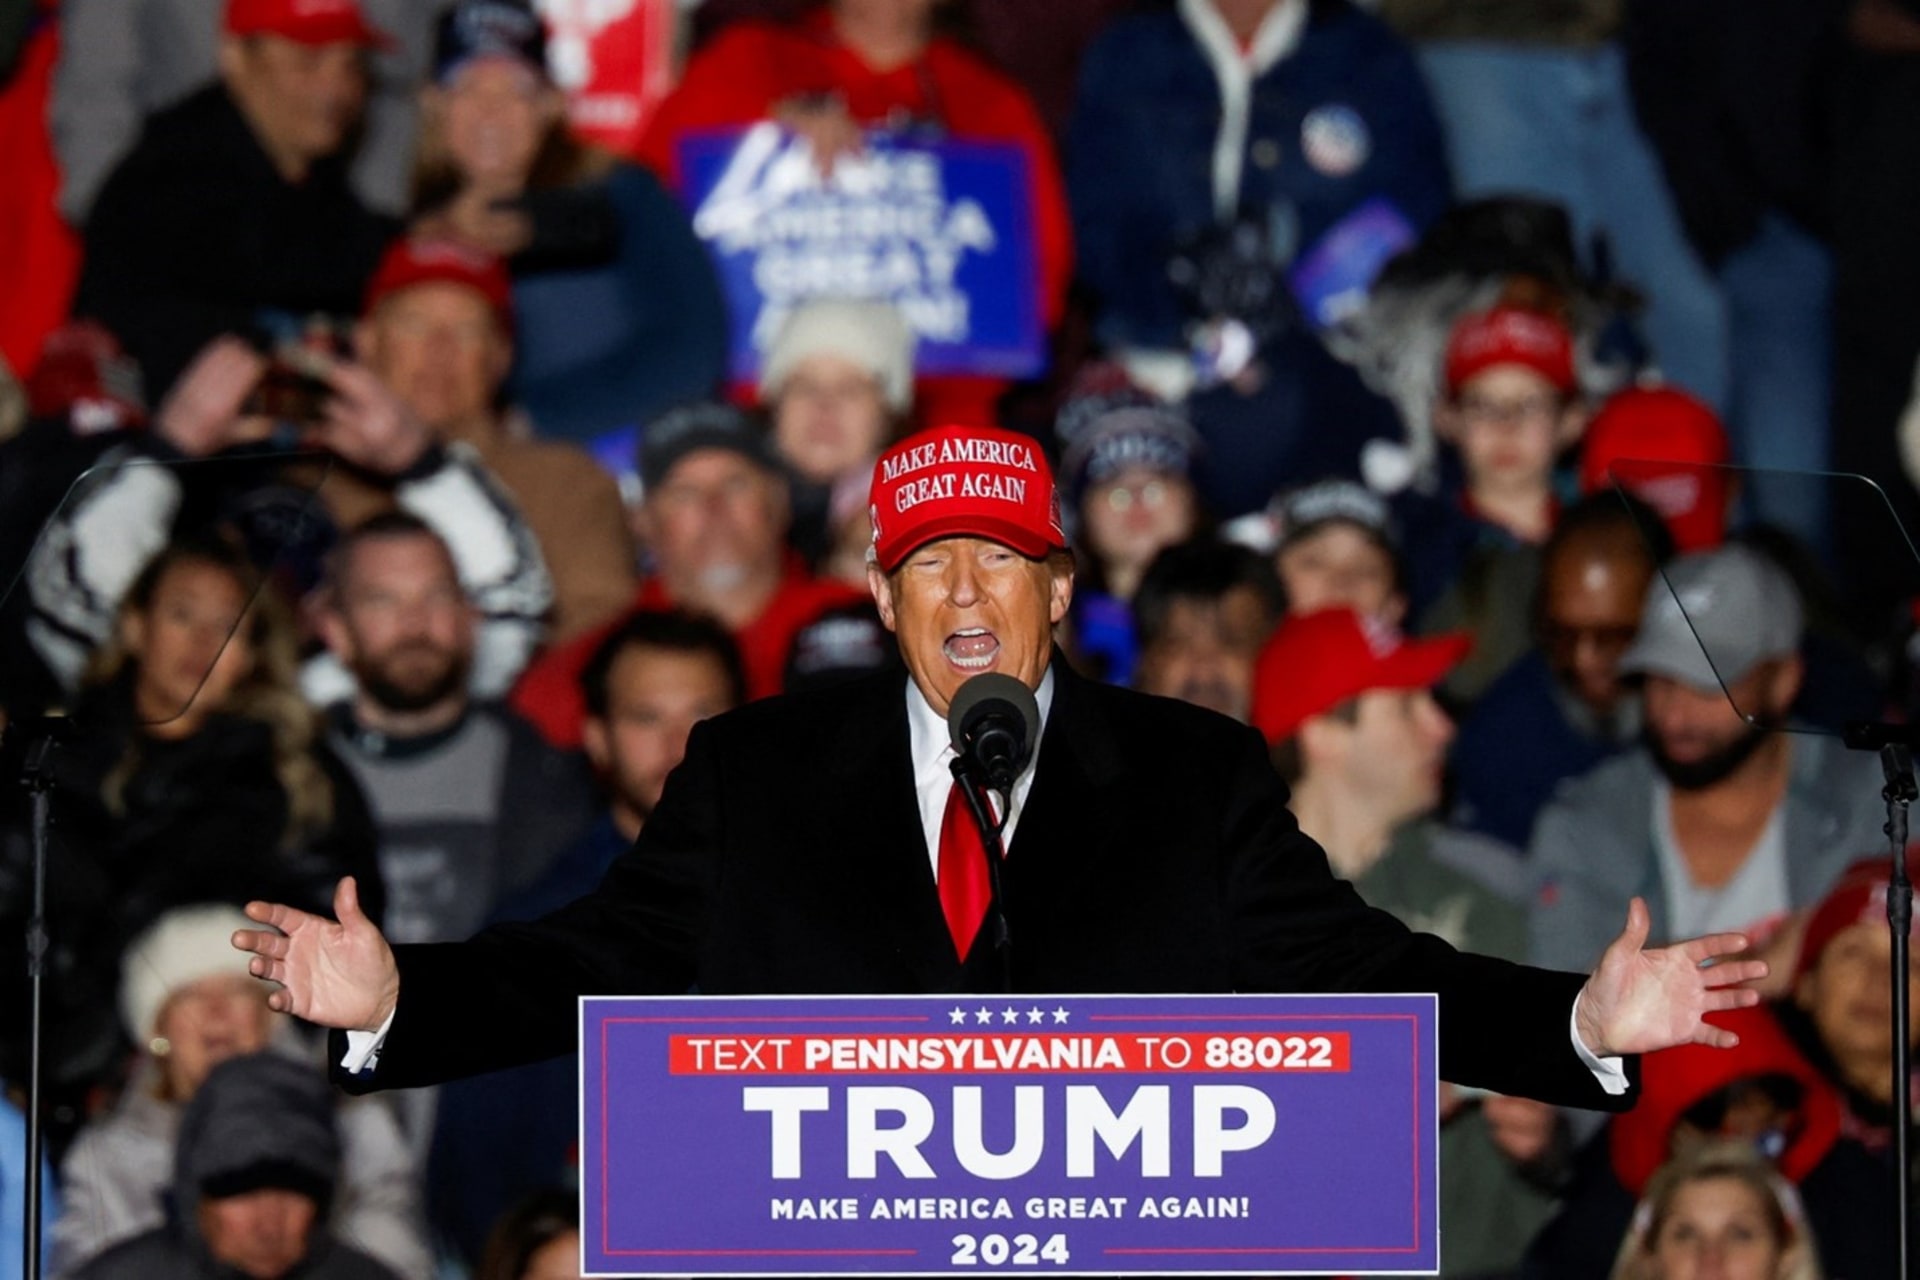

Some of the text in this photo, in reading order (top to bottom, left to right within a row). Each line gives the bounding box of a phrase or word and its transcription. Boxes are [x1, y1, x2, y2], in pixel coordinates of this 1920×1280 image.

[882, 438, 1037, 484] MAKE AMERICA
[895, 472, 1027, 513] GREAT AGAIN
[686, 1036, 1333, 1070] TEXT PENNSYLVANIA TO 88022
[742, 1084, 1278, 1181] TRUMP
[770, 1196, 1250, 1220] MAKE AMERICA GREAT AGAIN!
[950, 1233, 1071, 1266] 2024
